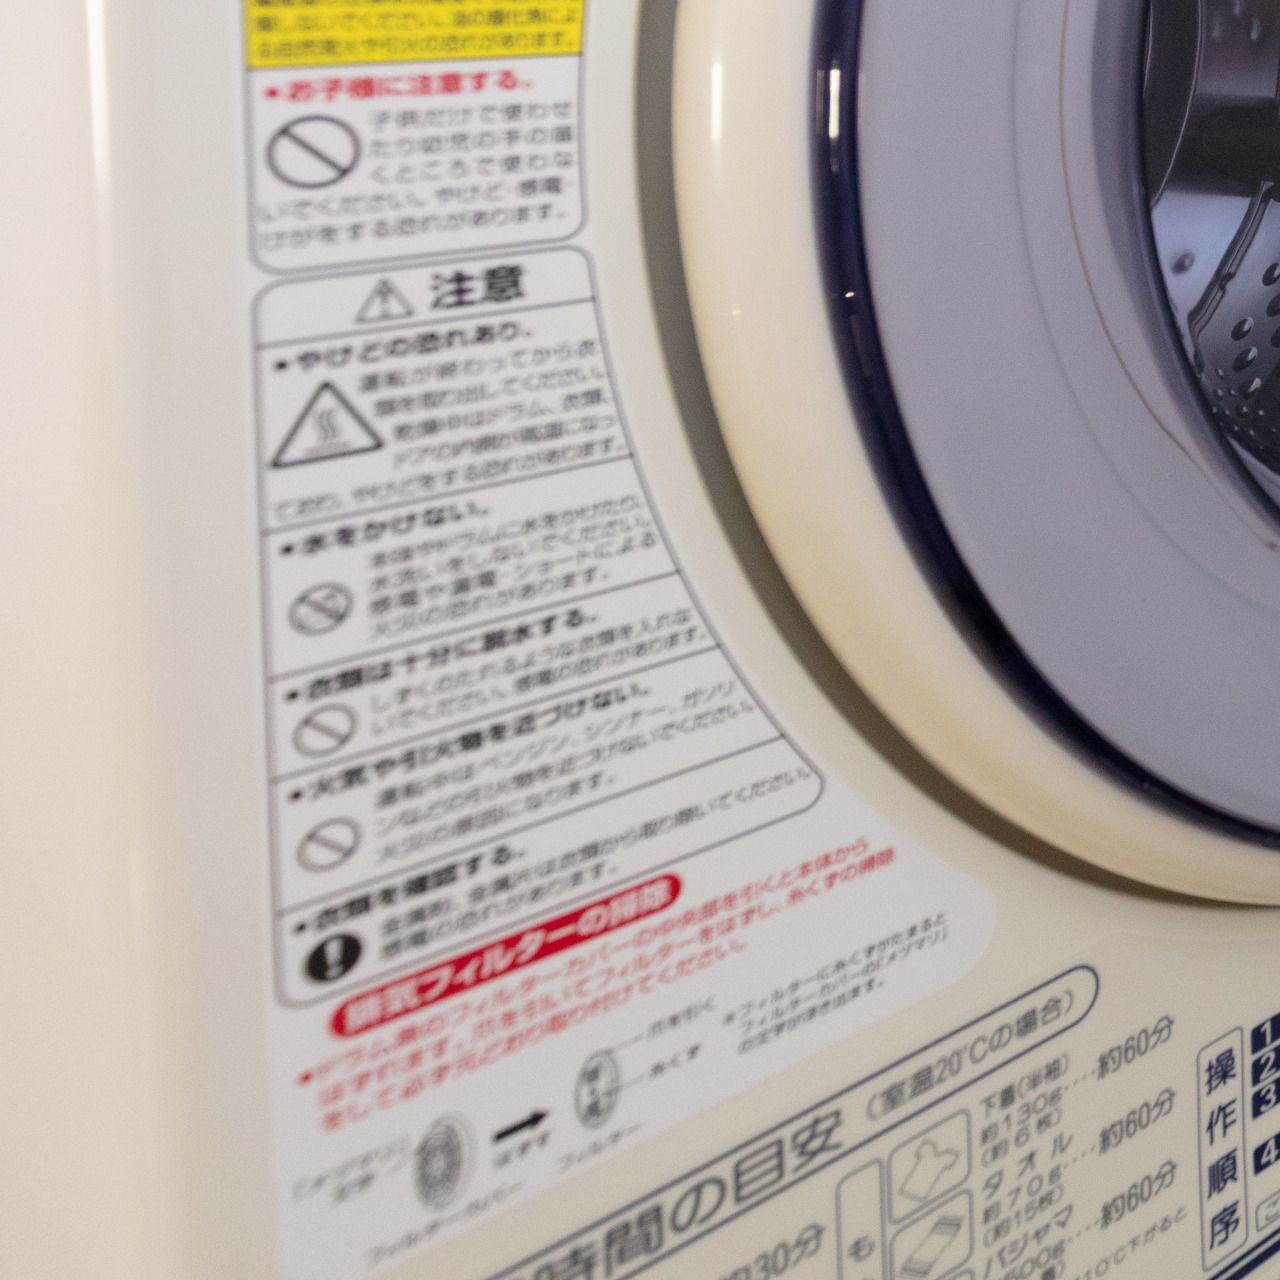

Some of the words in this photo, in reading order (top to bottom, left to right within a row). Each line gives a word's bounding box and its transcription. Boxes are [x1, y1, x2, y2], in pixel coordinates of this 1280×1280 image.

[430, 263, 526, 310] 注意
[346, 879, 675, 1033] 排気フィルターの掃除
[1098, 1014, 1176, 1080] 約60分
[1098, 1087, 1176, 1157] 約60分
[1204, 1049, 1239, 1250] 操作順序
[1100, 1159, 1178, 1228] 約60分
